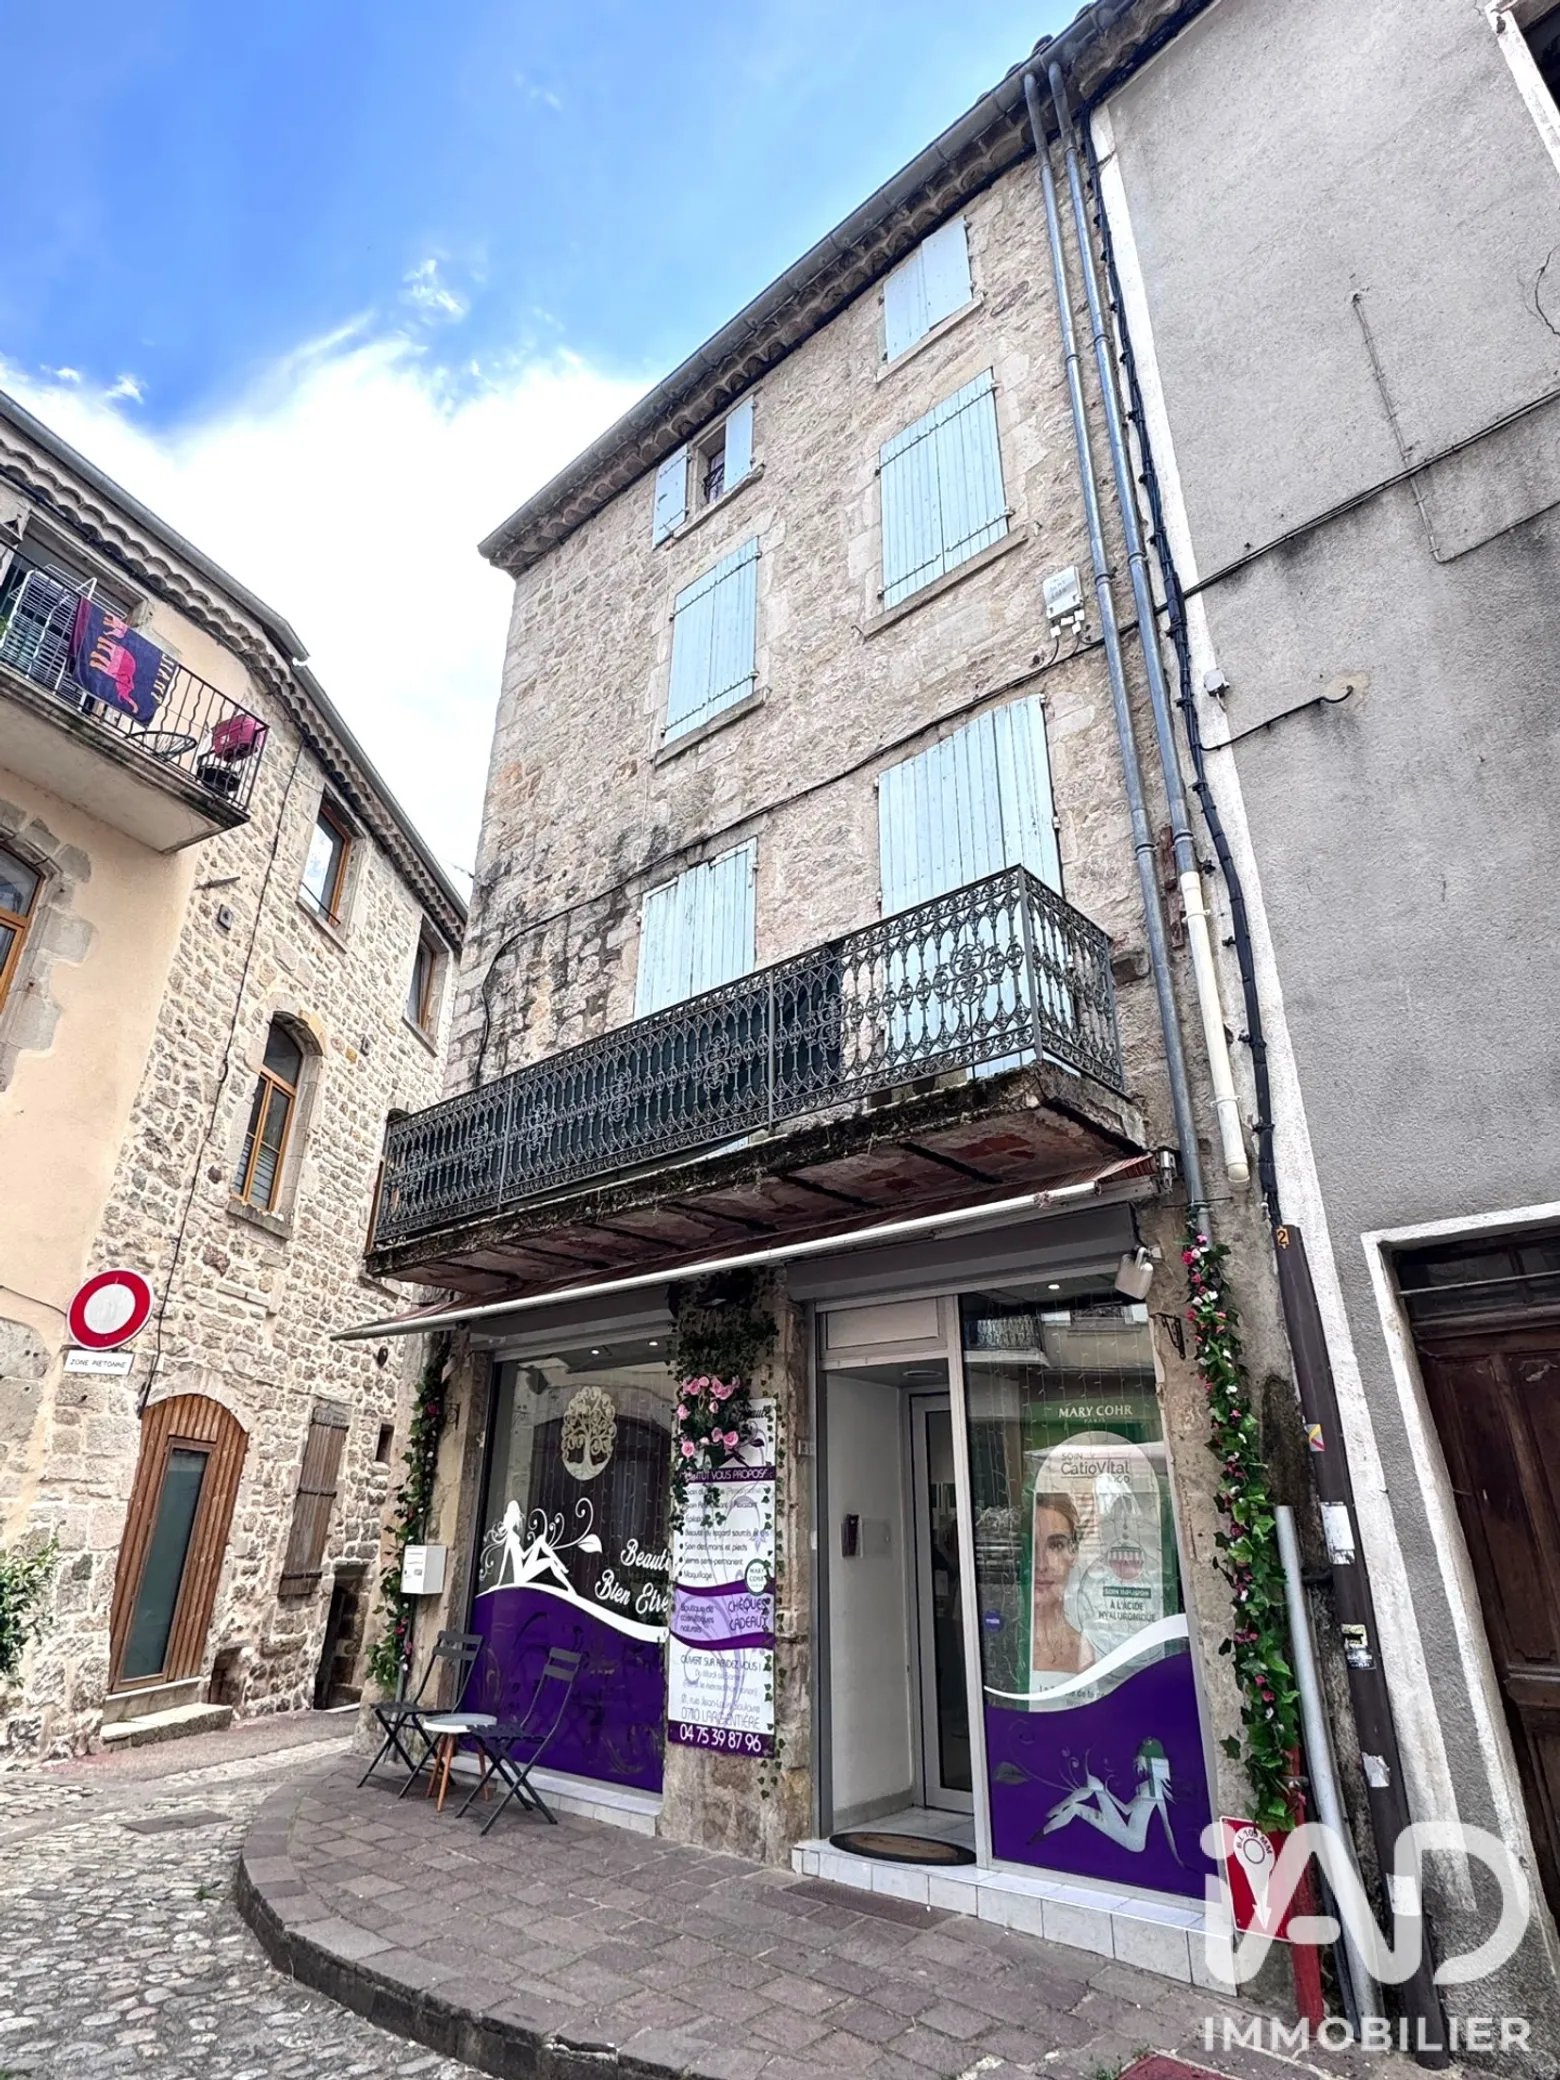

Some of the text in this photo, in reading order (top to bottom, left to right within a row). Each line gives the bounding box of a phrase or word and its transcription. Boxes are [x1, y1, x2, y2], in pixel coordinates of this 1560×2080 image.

[1277, 1230, 1287, 1244] 2
[70, 1358, 89, 1366] ZONE
[1058, 1405, 1133, 1418] MARY COHR
[1061, 1459, 1130, 1475] CatioVital
[711, 1470, 731, 1480] VOUS
[594, 1569, 630, 1606] Bien
[680, 1723, 762, 1752] 04 75 39 87 96
